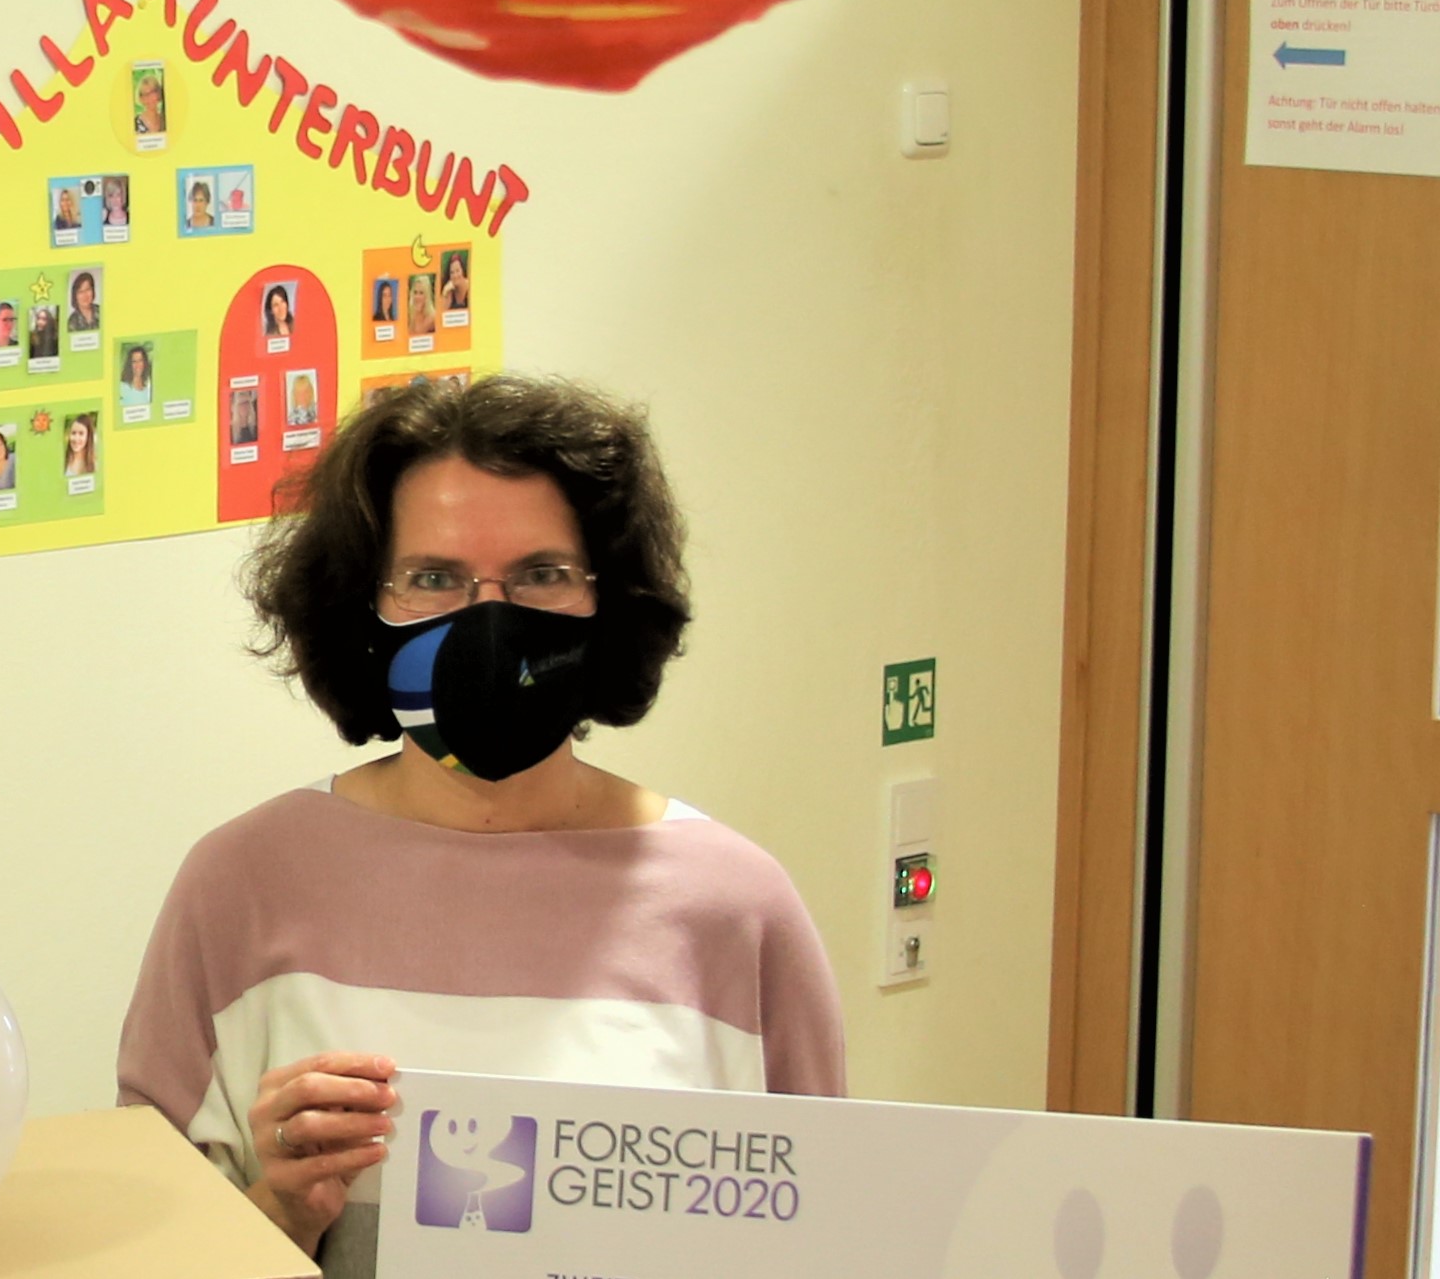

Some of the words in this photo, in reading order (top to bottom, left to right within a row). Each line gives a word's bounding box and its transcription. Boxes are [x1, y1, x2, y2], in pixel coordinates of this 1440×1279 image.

[1384, 0, 1410, 11] bitte
[1270, 19, 1300, 30] oben
[1302, 19, 1351, 32] drücken!
[1319, 97, 1337, 109] Tür
[1340, 98, 1368, 111] nicht
[1371, 100, 1402, 112] offen
[1267, 119, 1296, 131] sonst
[1298, 120, 1323, 134] geht
[1326, 120, 1344, 132] der
[1347, 120, 1380, 134] Alarm
[1383, 121, 1404, 135] los!
[554, 1120, 797, 1176] FORSCHER
[548, 1165, 680, 1212] GEIST
[685, 1174, 799, 1221] 2020
